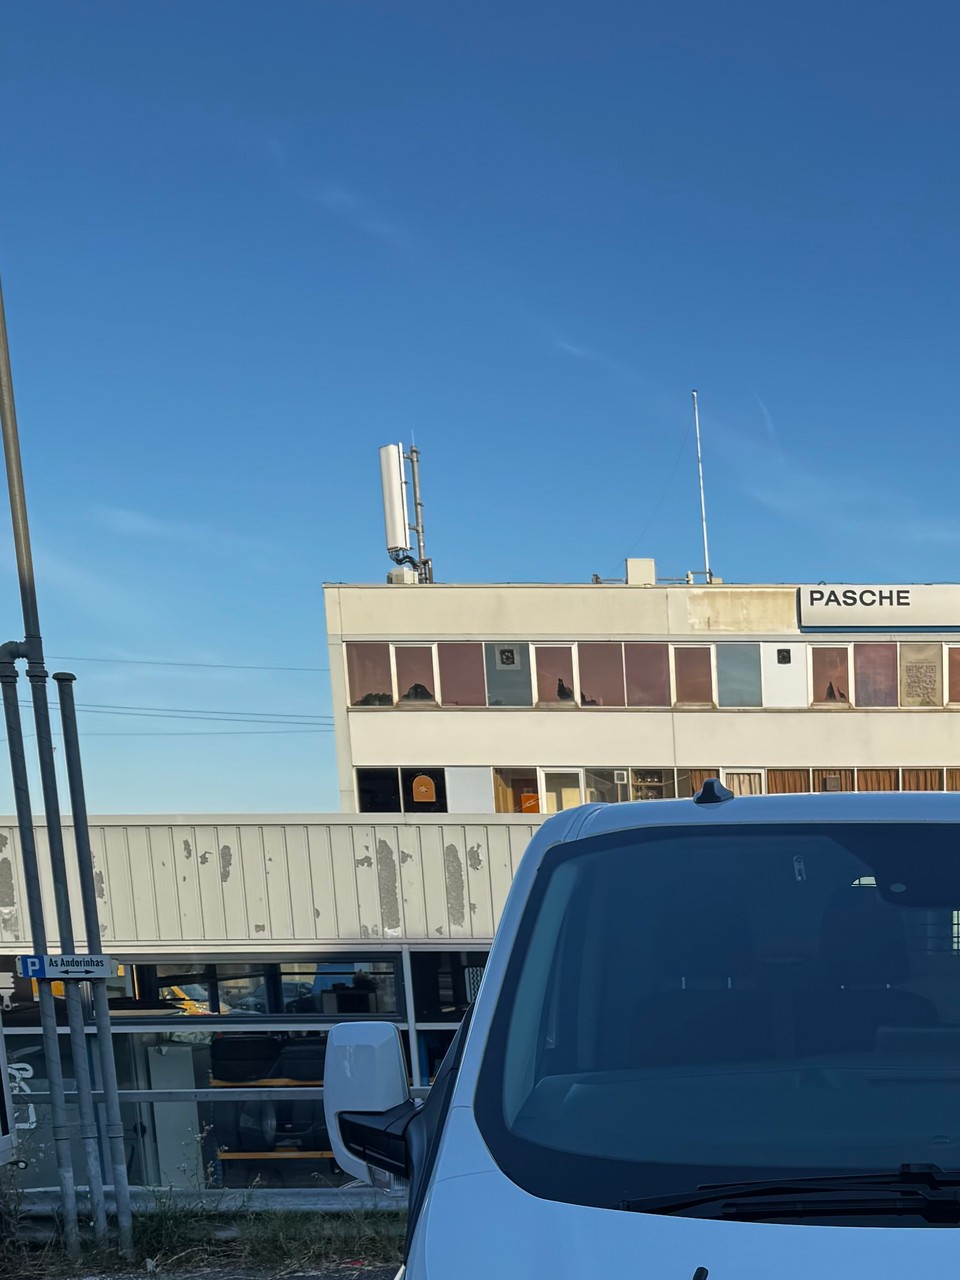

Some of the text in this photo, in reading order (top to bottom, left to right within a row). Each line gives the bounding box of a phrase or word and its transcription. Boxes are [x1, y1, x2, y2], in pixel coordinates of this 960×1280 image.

[809, 589, 911, 607] PASCHE
[48, 957, 59, 968] As
[60, 957, 104, 968] Andorinhas
